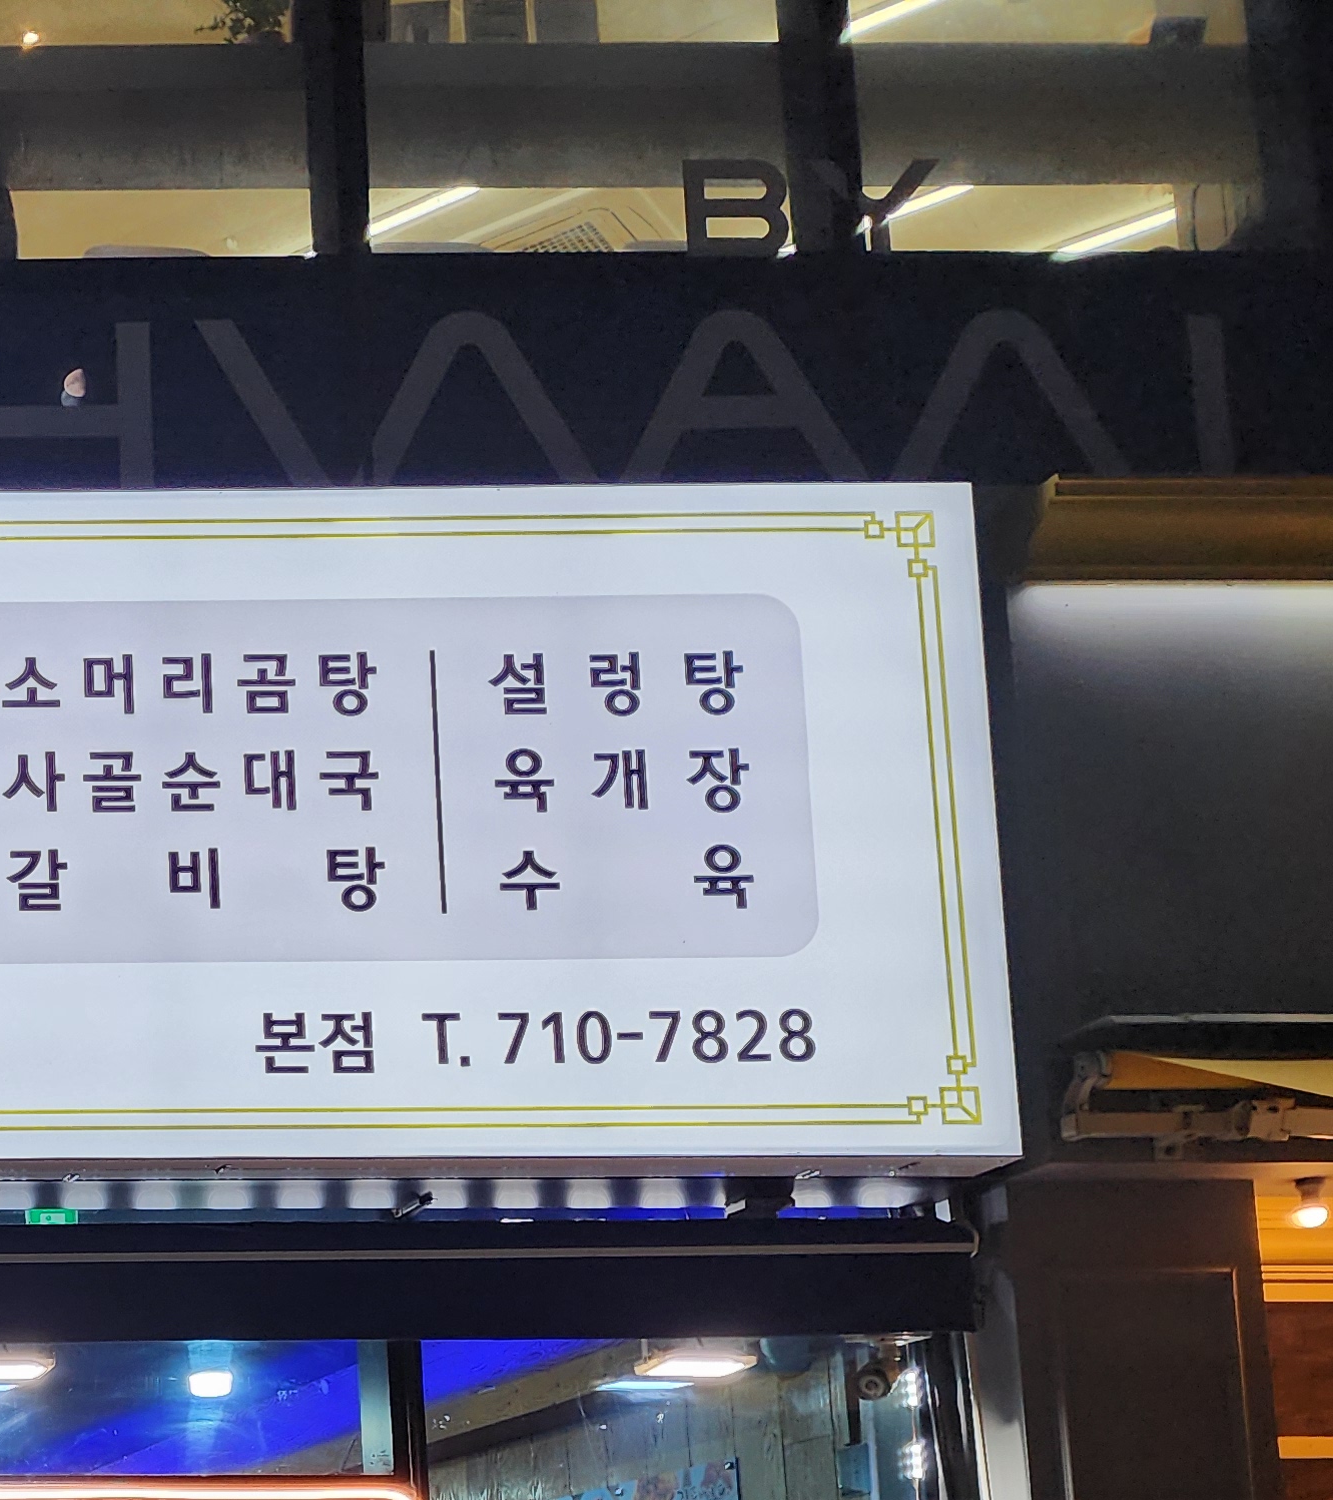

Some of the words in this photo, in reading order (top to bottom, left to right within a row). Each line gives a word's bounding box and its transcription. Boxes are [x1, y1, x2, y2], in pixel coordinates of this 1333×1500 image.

[489, 650, 743, 716] 설렁탕
[495, 748, 749, 814] 육개장
[255, 1010, 376, 1075] 본점
[496, 1009, 817, 1065] 710-7828
